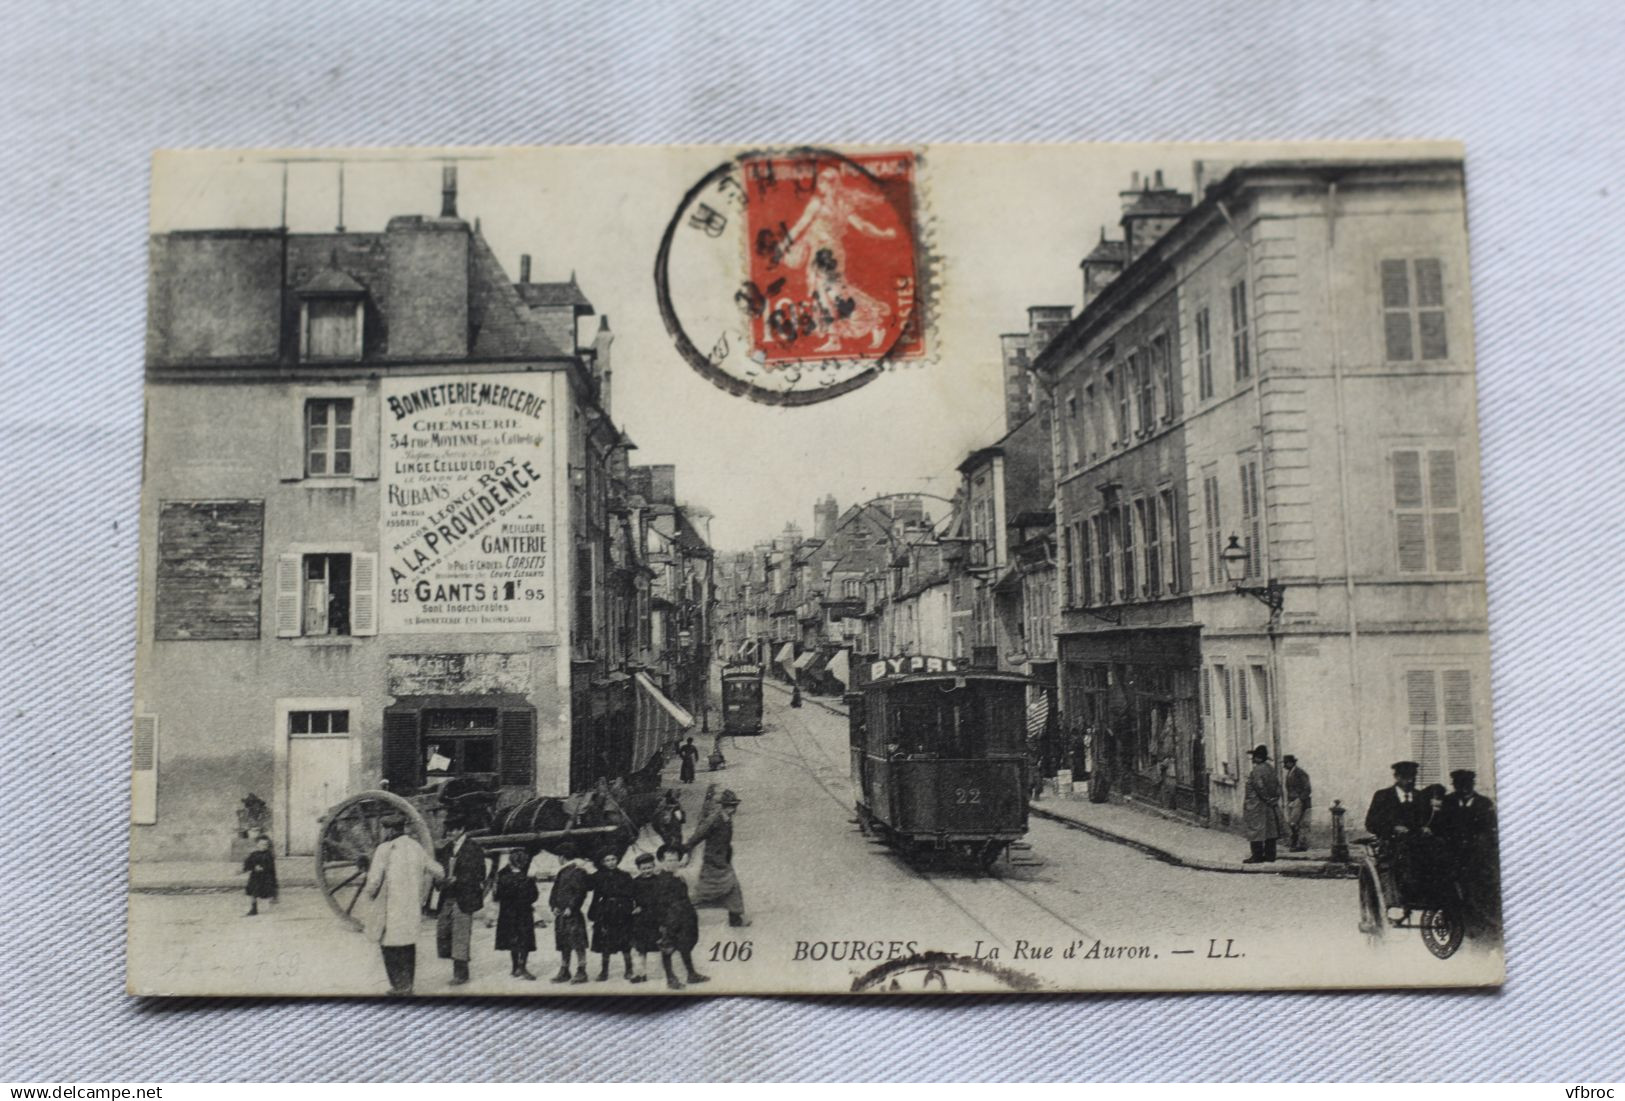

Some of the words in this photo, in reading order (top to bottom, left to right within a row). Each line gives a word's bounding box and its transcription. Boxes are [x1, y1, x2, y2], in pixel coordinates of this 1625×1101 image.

[480, 383, 547, 419] MERCERIE
[413, 419, 522, 432] CHEMISERIE
[390, 433, 409, 449] 34
[431, 433, 478, 448] MOYENNE
[395, 461, 431, 474] LINGE
[433, 459, 496, 473] CELLULOID
[477, 456, 518, 488] ROY
[388, 483, 451, 507] RUBANS
[402, 549, 430, 572] LA
[424, 460, 541, 555] PROVIDENCE
[481, 535, 547, 554] GANTERIE
[505, 555, 546, 570] CORSETS
[391, 588, 409, 603] SES
[415, 580, 486, 602] GANTS
[525, 589, 545, 601] 95
[955, 788, 981, 804] 22
[708, 941, 753, 962] 106
[792, 940, 918, 961] BOURGES
[974, 940, 999, 960] La
[1013, 939, 1053, 960] Rue
[1063, 939, 1159, 960] d'Auron.
[1206, 939, 1246, 959] LL.
